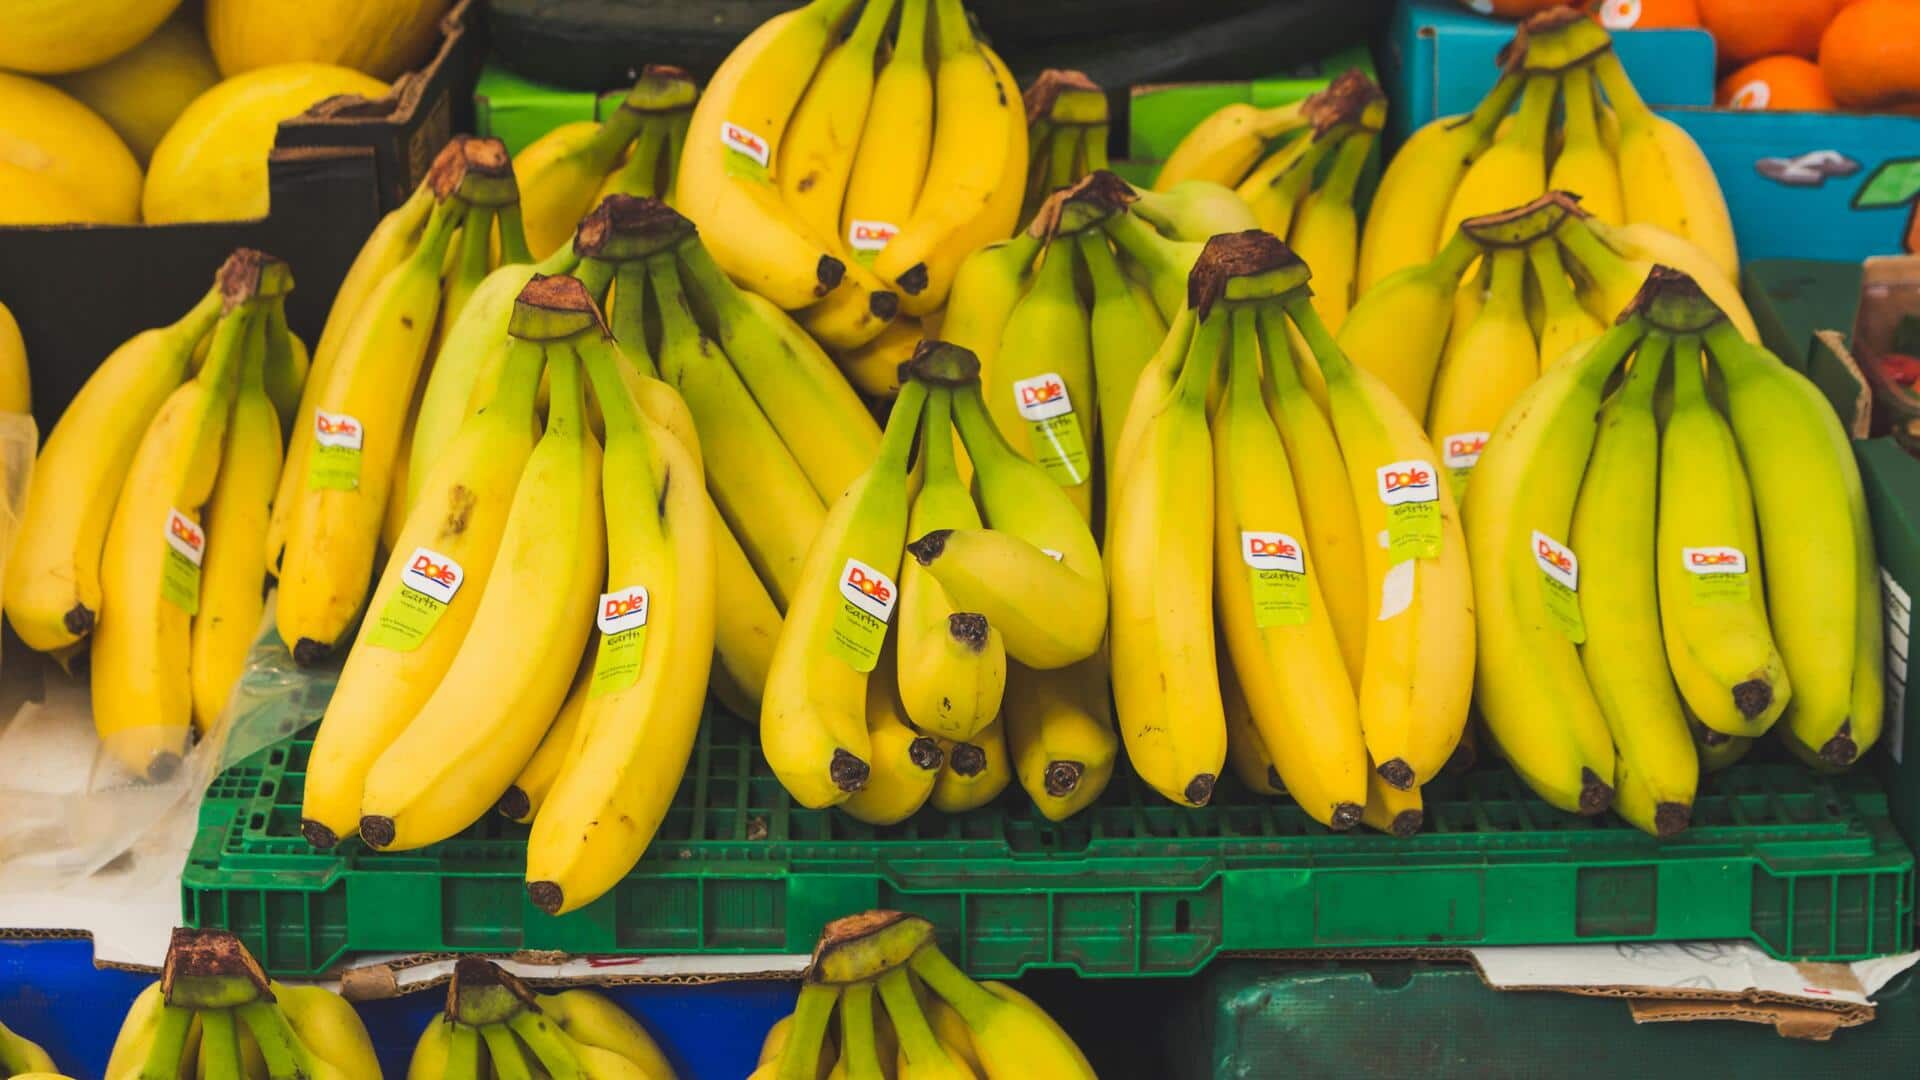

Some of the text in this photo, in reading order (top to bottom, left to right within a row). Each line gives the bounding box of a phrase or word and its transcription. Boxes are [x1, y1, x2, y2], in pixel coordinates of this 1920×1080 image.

[729, 128, 763, 154] Dole
[1022, 381, 1061, 404] Dole
[318, 415, 356, 436] Dole
[1385, 467, 1429, 489] Dole
[172, 516, 201, 550] Dole
[1249, 539, 1296, 556] Dole
[1539, 540, 1571, 571] Dole
[1692, 552, 1738, 565] Dole
[412, 555, 456, 584] Dole
[847, 567, 891, 601] Dole
[605, 594, 643, 617] Dole
